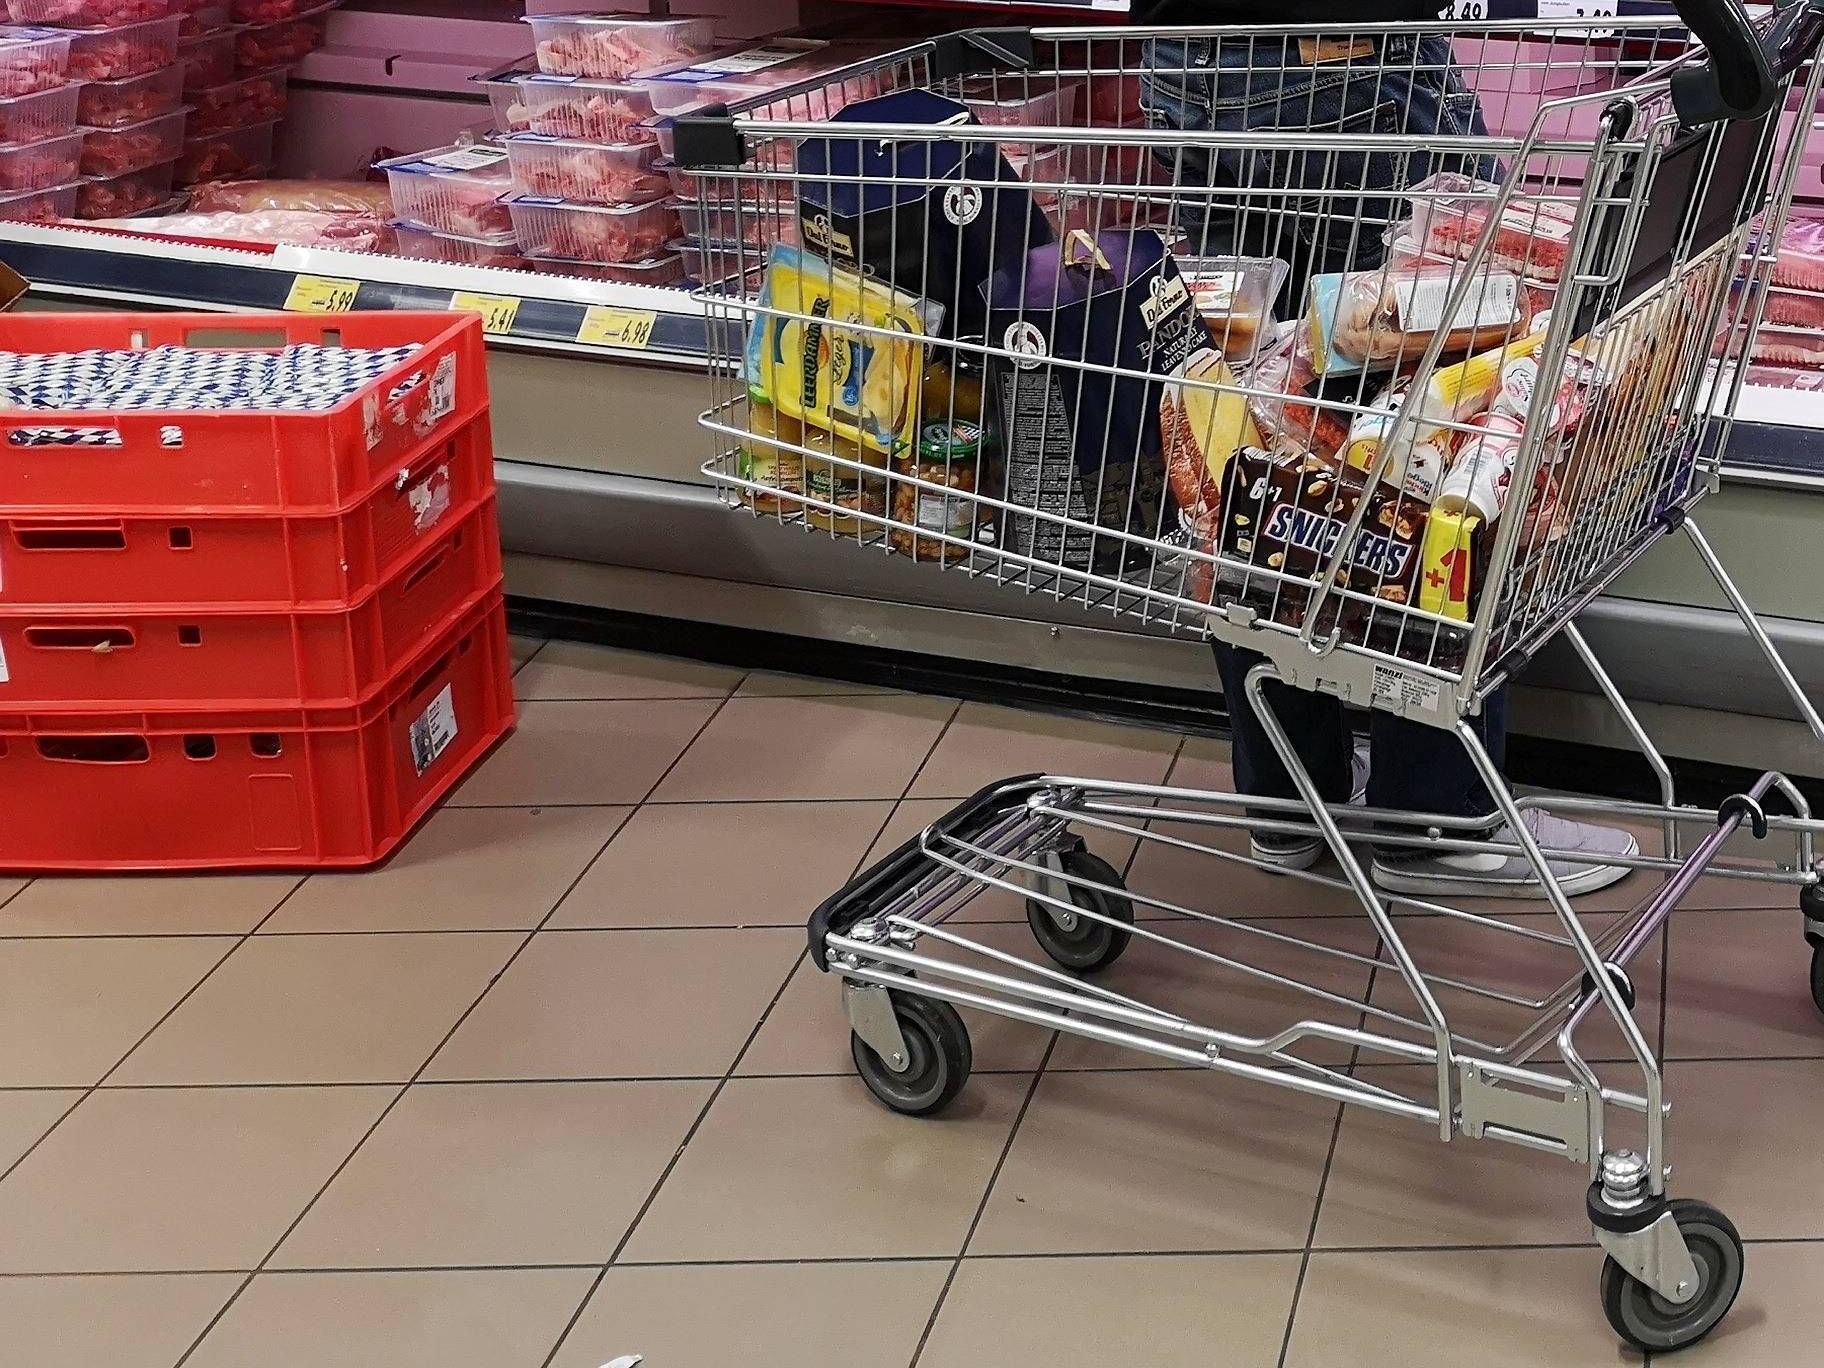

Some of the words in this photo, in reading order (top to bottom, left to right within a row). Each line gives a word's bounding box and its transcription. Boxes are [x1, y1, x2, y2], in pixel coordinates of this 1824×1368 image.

[324, 290, 354, 312] 5.99
[487, 308, 513, 332] 5.41
[621, 318, 650, 344] 6.98
[1250, 479, 1283, 503] 6+1
[1270, 507, 1407, 578] SNICERS
[1425, 547, 1469, 603] +1
